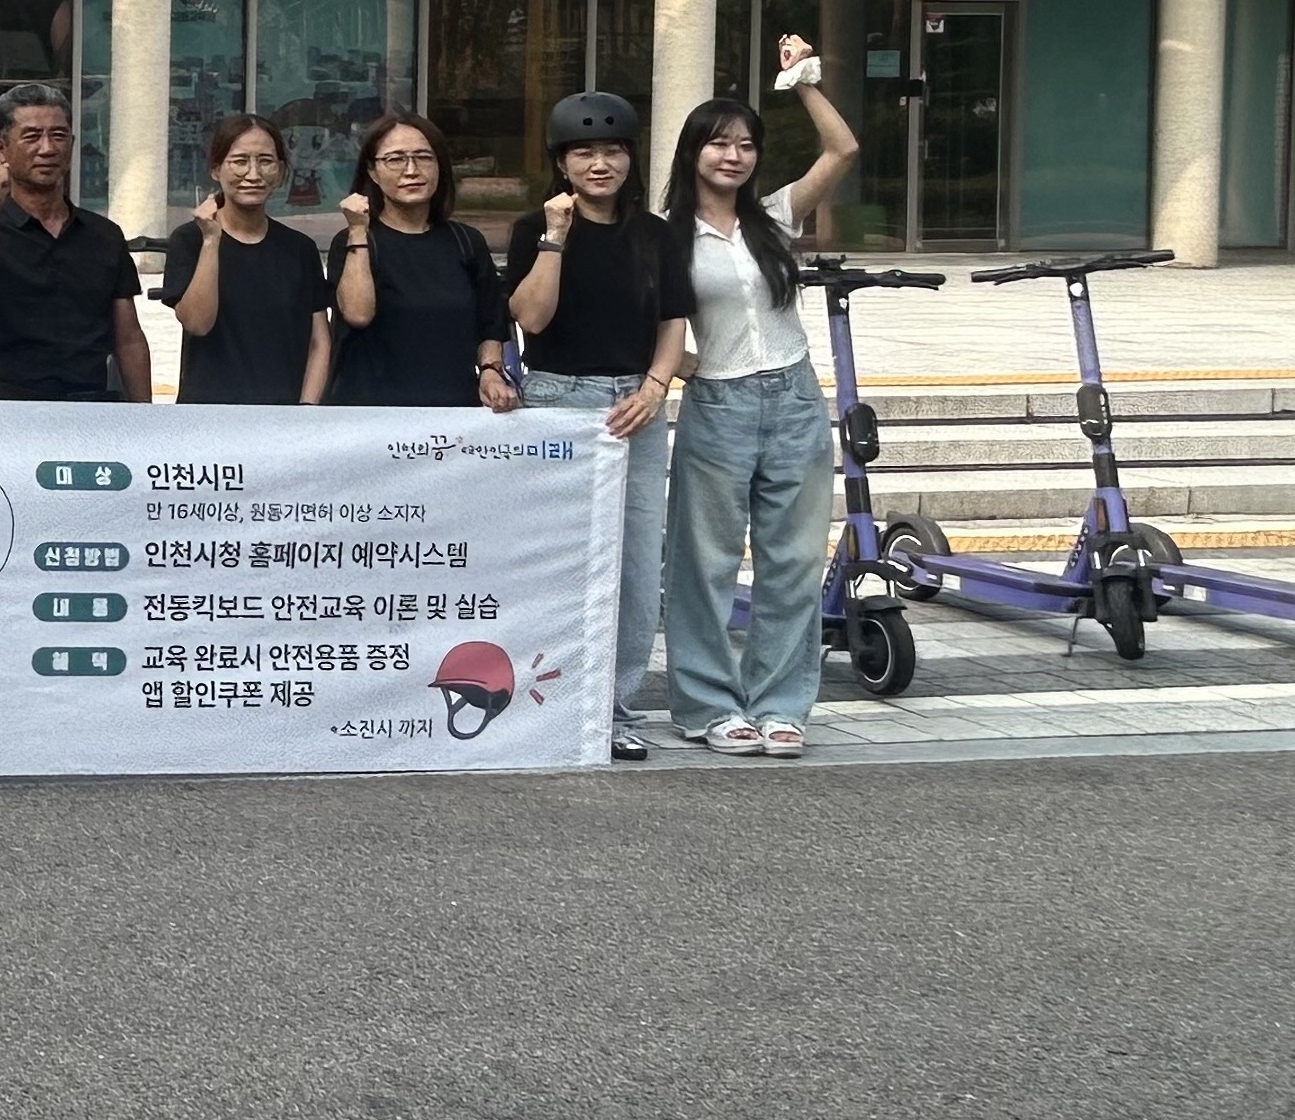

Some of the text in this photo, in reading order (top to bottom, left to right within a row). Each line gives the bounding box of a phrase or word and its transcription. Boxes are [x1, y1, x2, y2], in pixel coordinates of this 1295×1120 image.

[146, 463, 244, 491] 인천시민
[146, 501, 427, 524] 만 16세이상, 원동기면허 이상 소지자
[145, 540, 469, 570] 인천시청 홈페이지 예약시스템
[143, 593, 501, 622] 전동킥보드 안전교육 이론 및 실습
[141, 644, 188, 672] 교육
[193, 644, 261, 672] 완료시
[268, 643, 359, 672] 안전용품
[366, 643, 410, 671] 증정
[141, 680, 315, 709] 앱 할인쿠폰 제공
[398, 717, 433, 739] 까지
